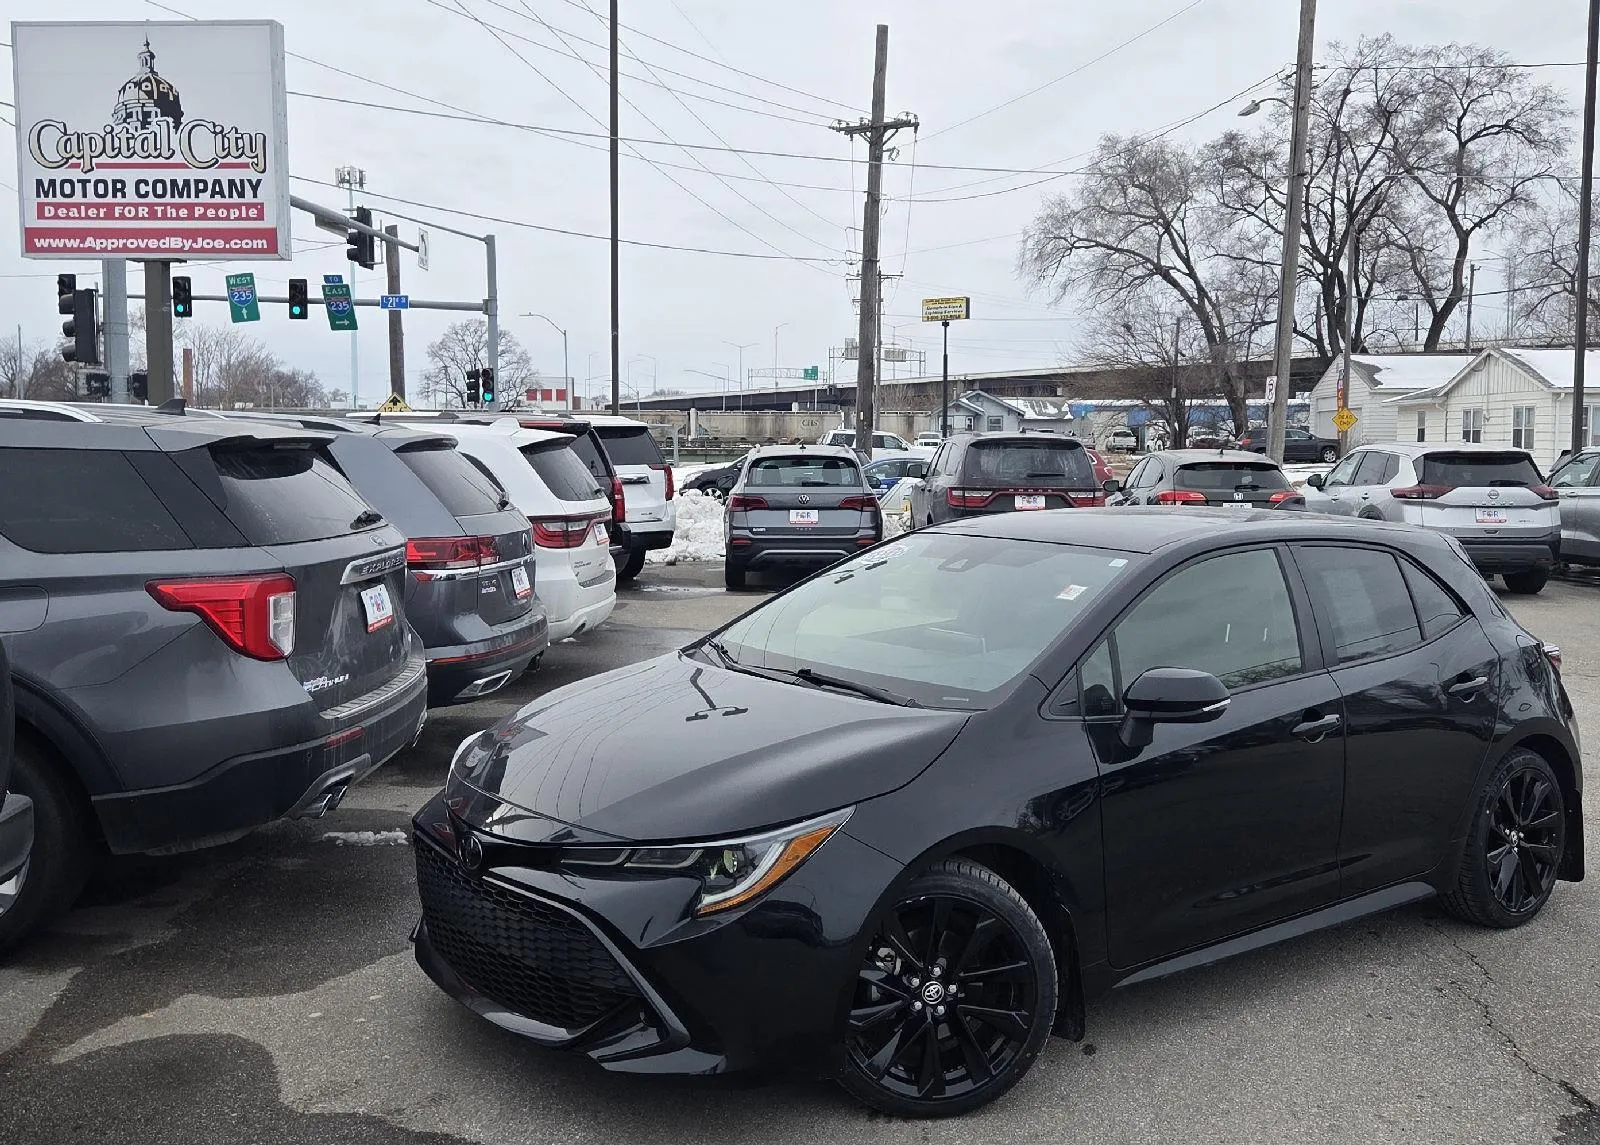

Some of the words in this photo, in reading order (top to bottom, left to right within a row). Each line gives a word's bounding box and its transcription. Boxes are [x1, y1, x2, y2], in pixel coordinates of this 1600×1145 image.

[28, 119, 175, 173] Capital
[179, 119, 266, 173] City
[35, 178, 127, 199] MOTOR
[134, 178, 263, 199] COMPANY
[44, 205, 107, 218] Dealer
[114, 206, 149, 218] FOR
[154, 205, 188, 218] The
[194, 206, 258, 221] People
[33, 235, 268, 251] www.ApprovedByJoe.com
[229, 276, 251, 285] WEST
[232, 290, 252, 301] 235
[325, 287, 347, 295] EAST
[330, 301, 350, 311] 235
